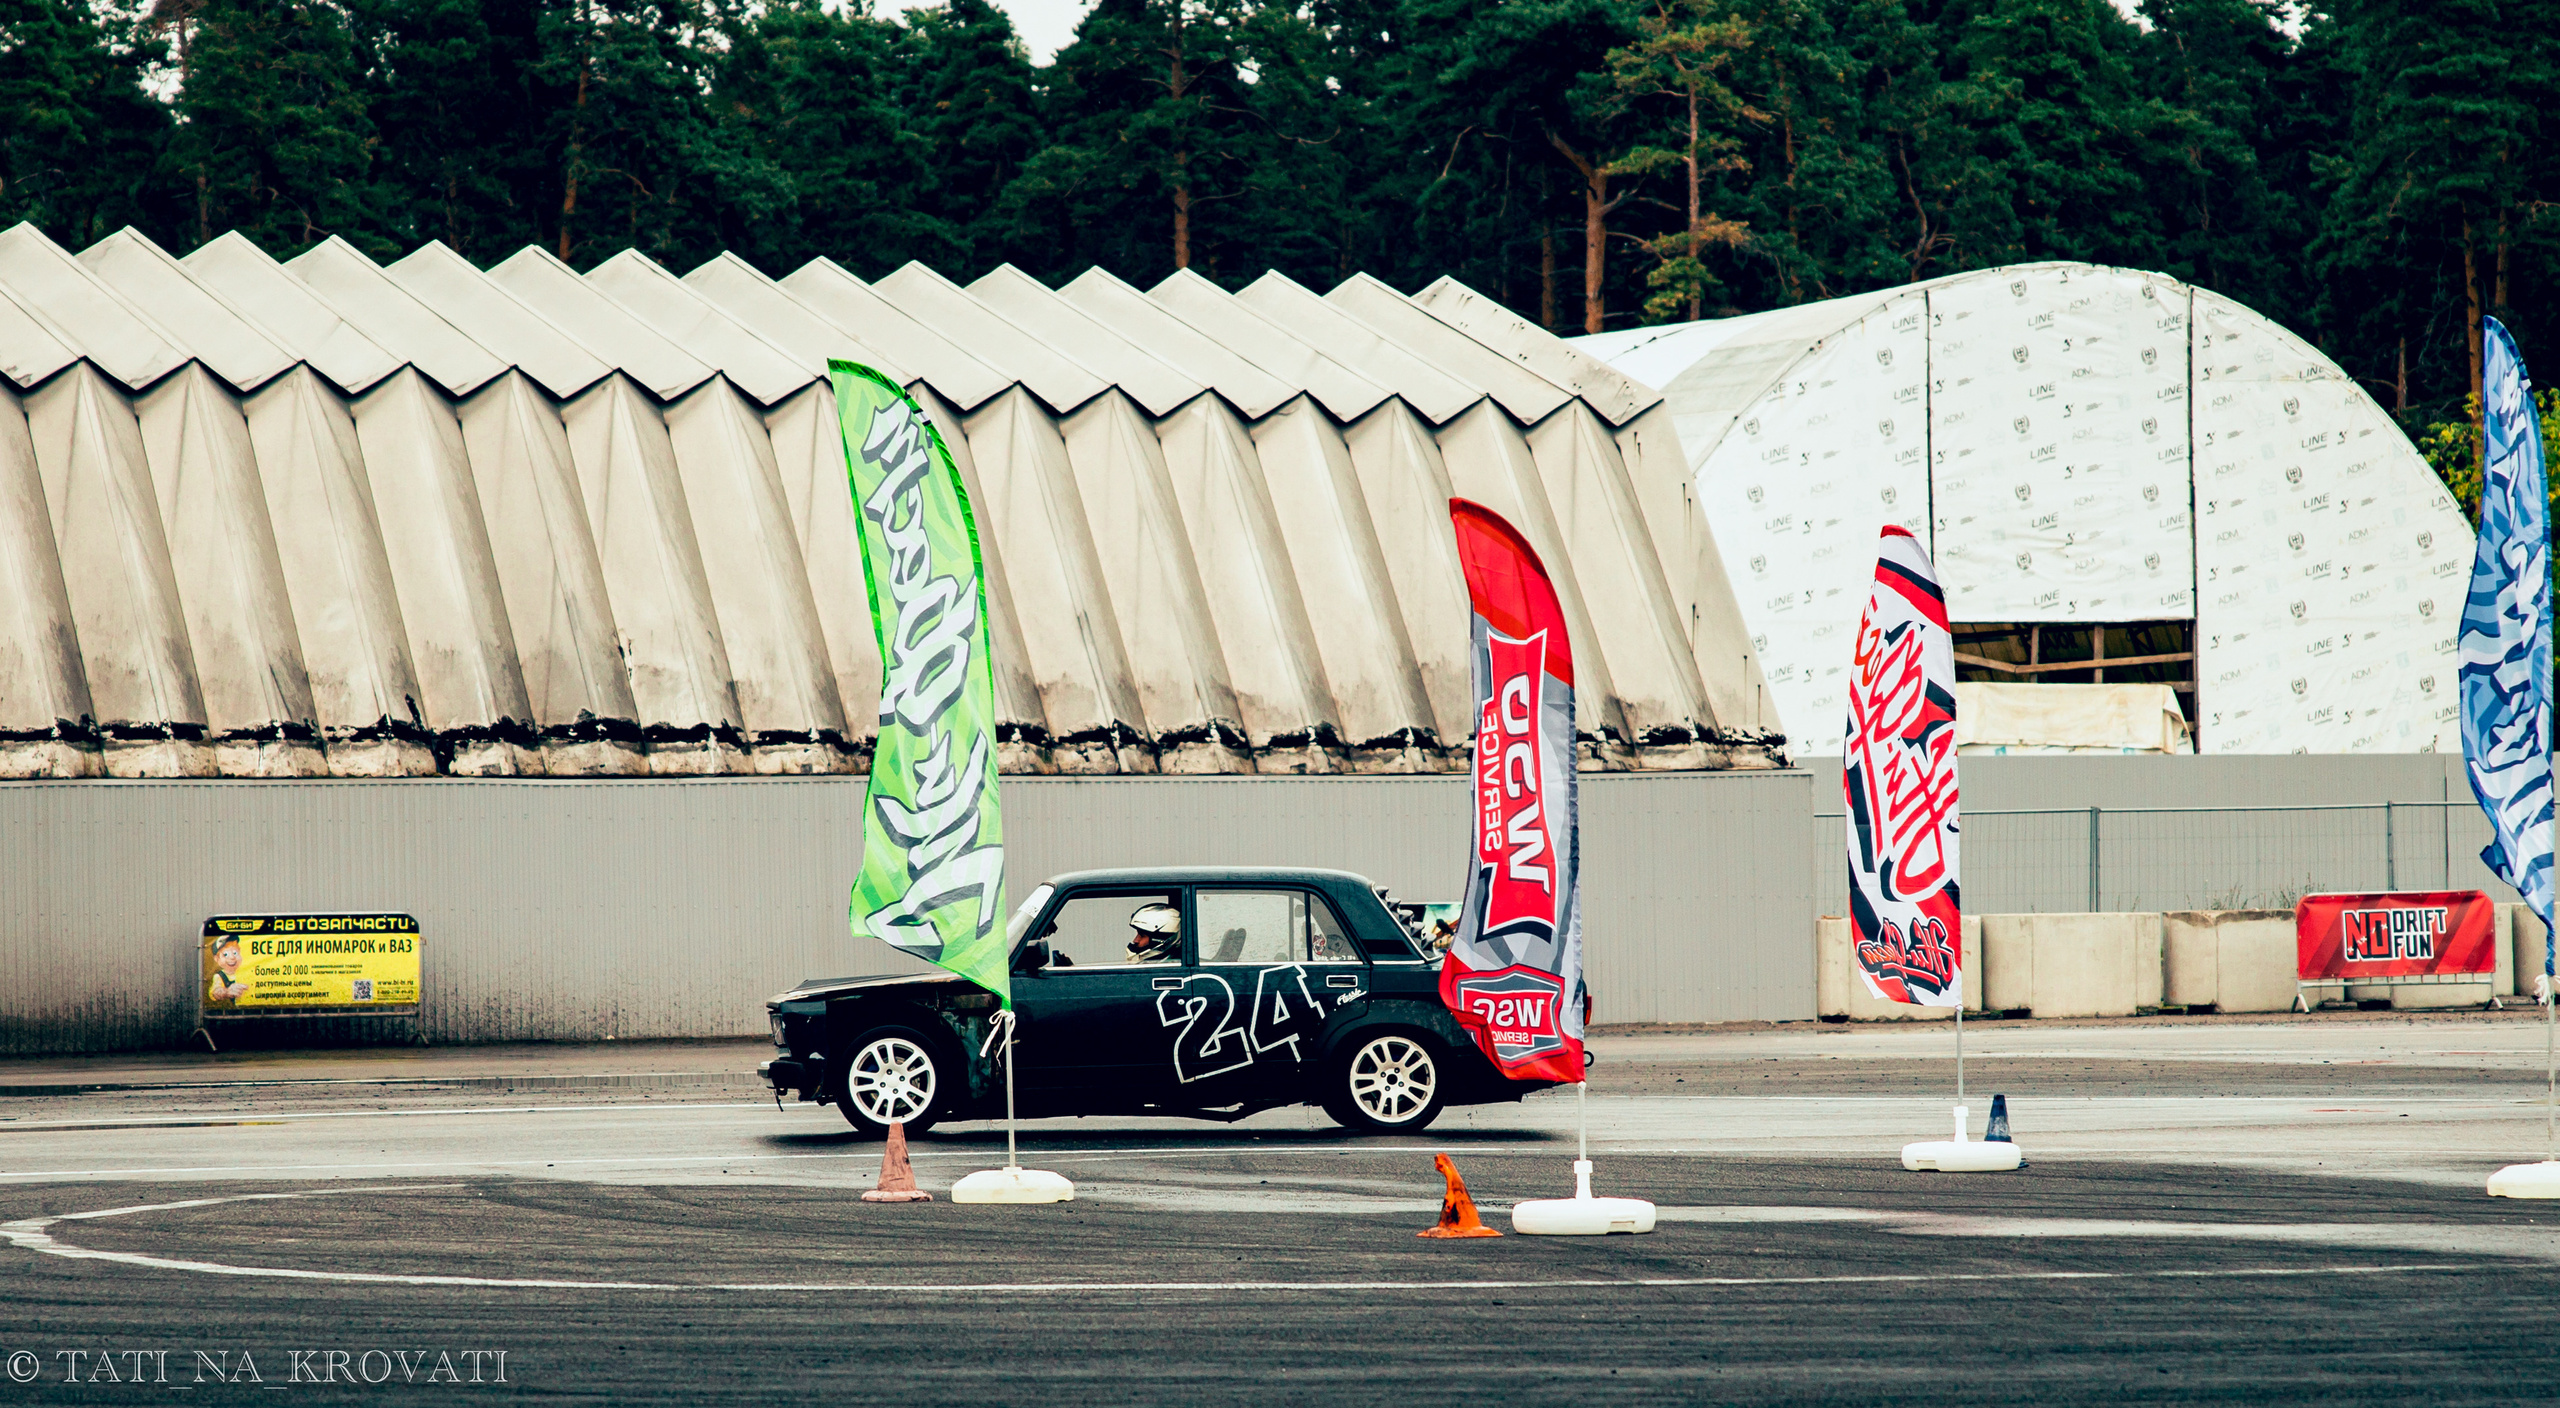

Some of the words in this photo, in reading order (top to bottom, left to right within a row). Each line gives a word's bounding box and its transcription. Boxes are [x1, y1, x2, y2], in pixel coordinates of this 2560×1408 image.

[1892, 314, 1919, 329] LINE
[2028, 311, 2054, 327] LINE
[2157, 314, 2182, 329] LINE
[1894, 385, 1919, 400] LINE
[2029, 381, 2056, 397] LINE
[2157, 384, 2183, 399] LINE
[2302, 432, 2328, 448] LINE
[1762, 445, 1789, 460] LINE
[1896, 447, 1920, 462] LINE
[2030, 443, 2056, 459] LINE
[2158, 444, 2184, 460] LINE
[2304, 493, 2330, 509] LINE
[1765, 514, 1793, 530] LINE
[2032, 512, 2059, 528] LINE
[2160, 513, 2185, 528] LINE
[2305, 560, 2332, 577] LINE
[2433, 559, 2458, 575] LINE
[1767, 593, 1794, 609] LINE
[2034, 590, 2060, 606] LINE
[2161, 589, 2187, 605] LINE
[2307, 637, 2333, 653] LINE
[1768, 664, 1794, 680] LINE
[2308, 705, 2334, 722] LINE
[226, 922, 252, 930] БИ-БИ
[273, 917, 409, 931] АВТОЗАПЧАСТИ
[2393, 909, 2447, 933] DRIFT
[2345, 911, 2392, 960] NO
[252, 941, 273, 955] ВСЕ
[276, 940, 303, 957] ДЛЯ
[306, 939, 376, 954] ИНОМАРОК
[379, 942, 386, 953] и
[390, 939, 412, 953] ВАЗ
[2393, 934, 2433, 958] FUN
[255, 965, 280, 976] более
[283, 965, 292, 975] 20
[294, 965, 308, 975] 000
[255, 981, 293, 989] доступные
[255, 991, 286, 1000] широкий
[287, 991, 330, 999] ассортимент
[1156, 964, 1326, 1084] 24
